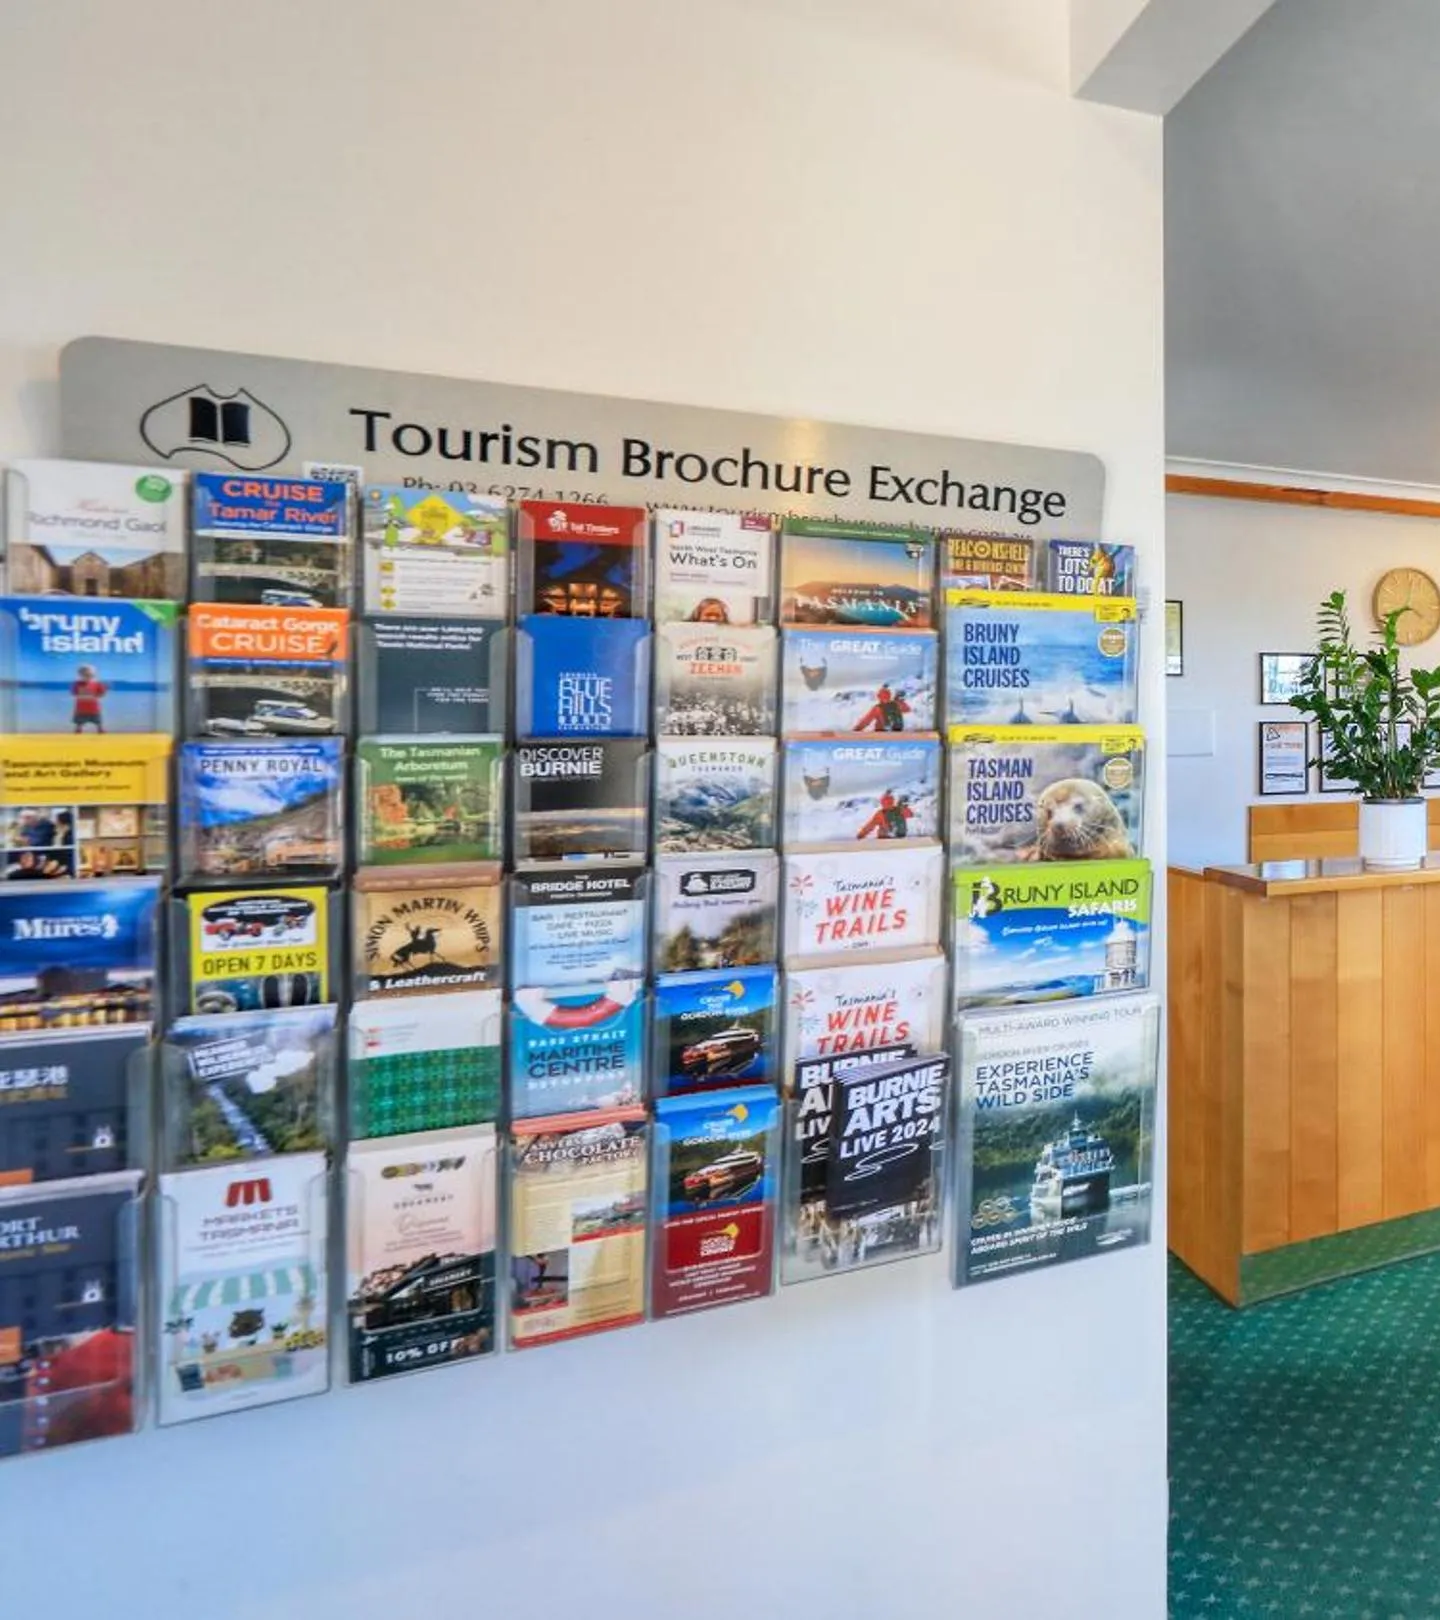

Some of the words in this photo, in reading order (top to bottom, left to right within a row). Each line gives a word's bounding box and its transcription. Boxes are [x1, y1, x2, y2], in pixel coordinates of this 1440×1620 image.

[349, 409, 598, 472] Tourism
[621, 438, 850, 497] Brochure
[869, 466, 1066, 523] Exchange
[222, 480, 324, 502] CRUISE
[209, 502, 276, 520] Tamar
[285, 508, 338, 524] River
[670, 552, 728, 568] What's
[733, 555, 757, 569] On
[1058, 545, 1090, 557] THERE'S
[1058, 558, 1090, 575] LOTS
[1058, 575, 1074, 591] TO
[1097, 578, 1115, 594] AT
[795, 594, 917, 614] TASMANIA
[197, 614, 279, 630] Cataract
[283, 618, 339, 634] Gorge
[963, 623, 1020, 643] BRUNY
[41, 631, 144, 653] island
[210, 632, 329, 654] CRUISE
[831, 639, 881, 654] GREAT
[883, 642, 923, 656] Guide
[963, 646, 1020, 665] ISLAND
[963, 668, 1030, 688] CRUISES
[379, 748, 407, 759] The
[410, 745, 481, 758] Tasmanian
[519, 746, 603, 762] DISCOVER
[832, 746, 883, 761] GREAT
[201, 759, 258, 774] PENNY
[267, 758, 322, 772] ROYAL
[520, 761, 602, 777] BURNIE
[967, 758, 1033, 779] TASMAN
[967, 780, 1024, 801] ISLAND
[966, 802, 1033, 824] CRUISES
[531, 881, 584, 892] BRIDGE
[587, 878, 631, 889] HOTEL
[1069, 879, 1139, 900] ISLAND
[826, 888, 896, 916] WINE
[1067, 899, 1137, 918] SAFARIS
[12, 917, 100, 940] Mures
[392, 897, 463, 917] MARTIN
[464, 908, 490, 953] WHIPS
[816, 909, 907, 944] TRAILS
[203, 956, 249, 975] OPEN
[256, 955, 265, 970] 7
[272, 951, 317, 968] DAYS
[385, 972, 486, 990] Leathercraft
[827, 1002, 899, 1033] WINE
[1114, 1007, 1142, 1018] TOUR
[817, 1021, 911, 1054] TRAILS
[529, 1041, 624, 1062] MARITIME
[528, 1055, 625, 1079] CENTRE
[976, 1051, 1094, 1081] EXPERIENCE
[848, 1063, 944, 1110] BURNIE
[977, 1067, 1089, 1095] TASMANIA'S
[977, 1091, 1026, 1109] WILD
[1032, 1084, 1075, 1101] SIDE
[843, 1087, 941, 1137] ARTS
[796, 1115, 831, 1141] LIV
[839, 1129, 888, 1159] LIVE
[891, 1116, 940, 1144] 2024
[524, 1136, 641, 1164] CHOCOLATE
[0, 1216, 42, 1236] ORT
[202, 1205, 298, 1227] MARKETS
[0, 1226, 80, 1248] RTHUR
[201, 1219, 299, 1241] TASMANIA
[385, 1344, 423, 1364] 10%
[427, 1338, 461, 1355] OFF
